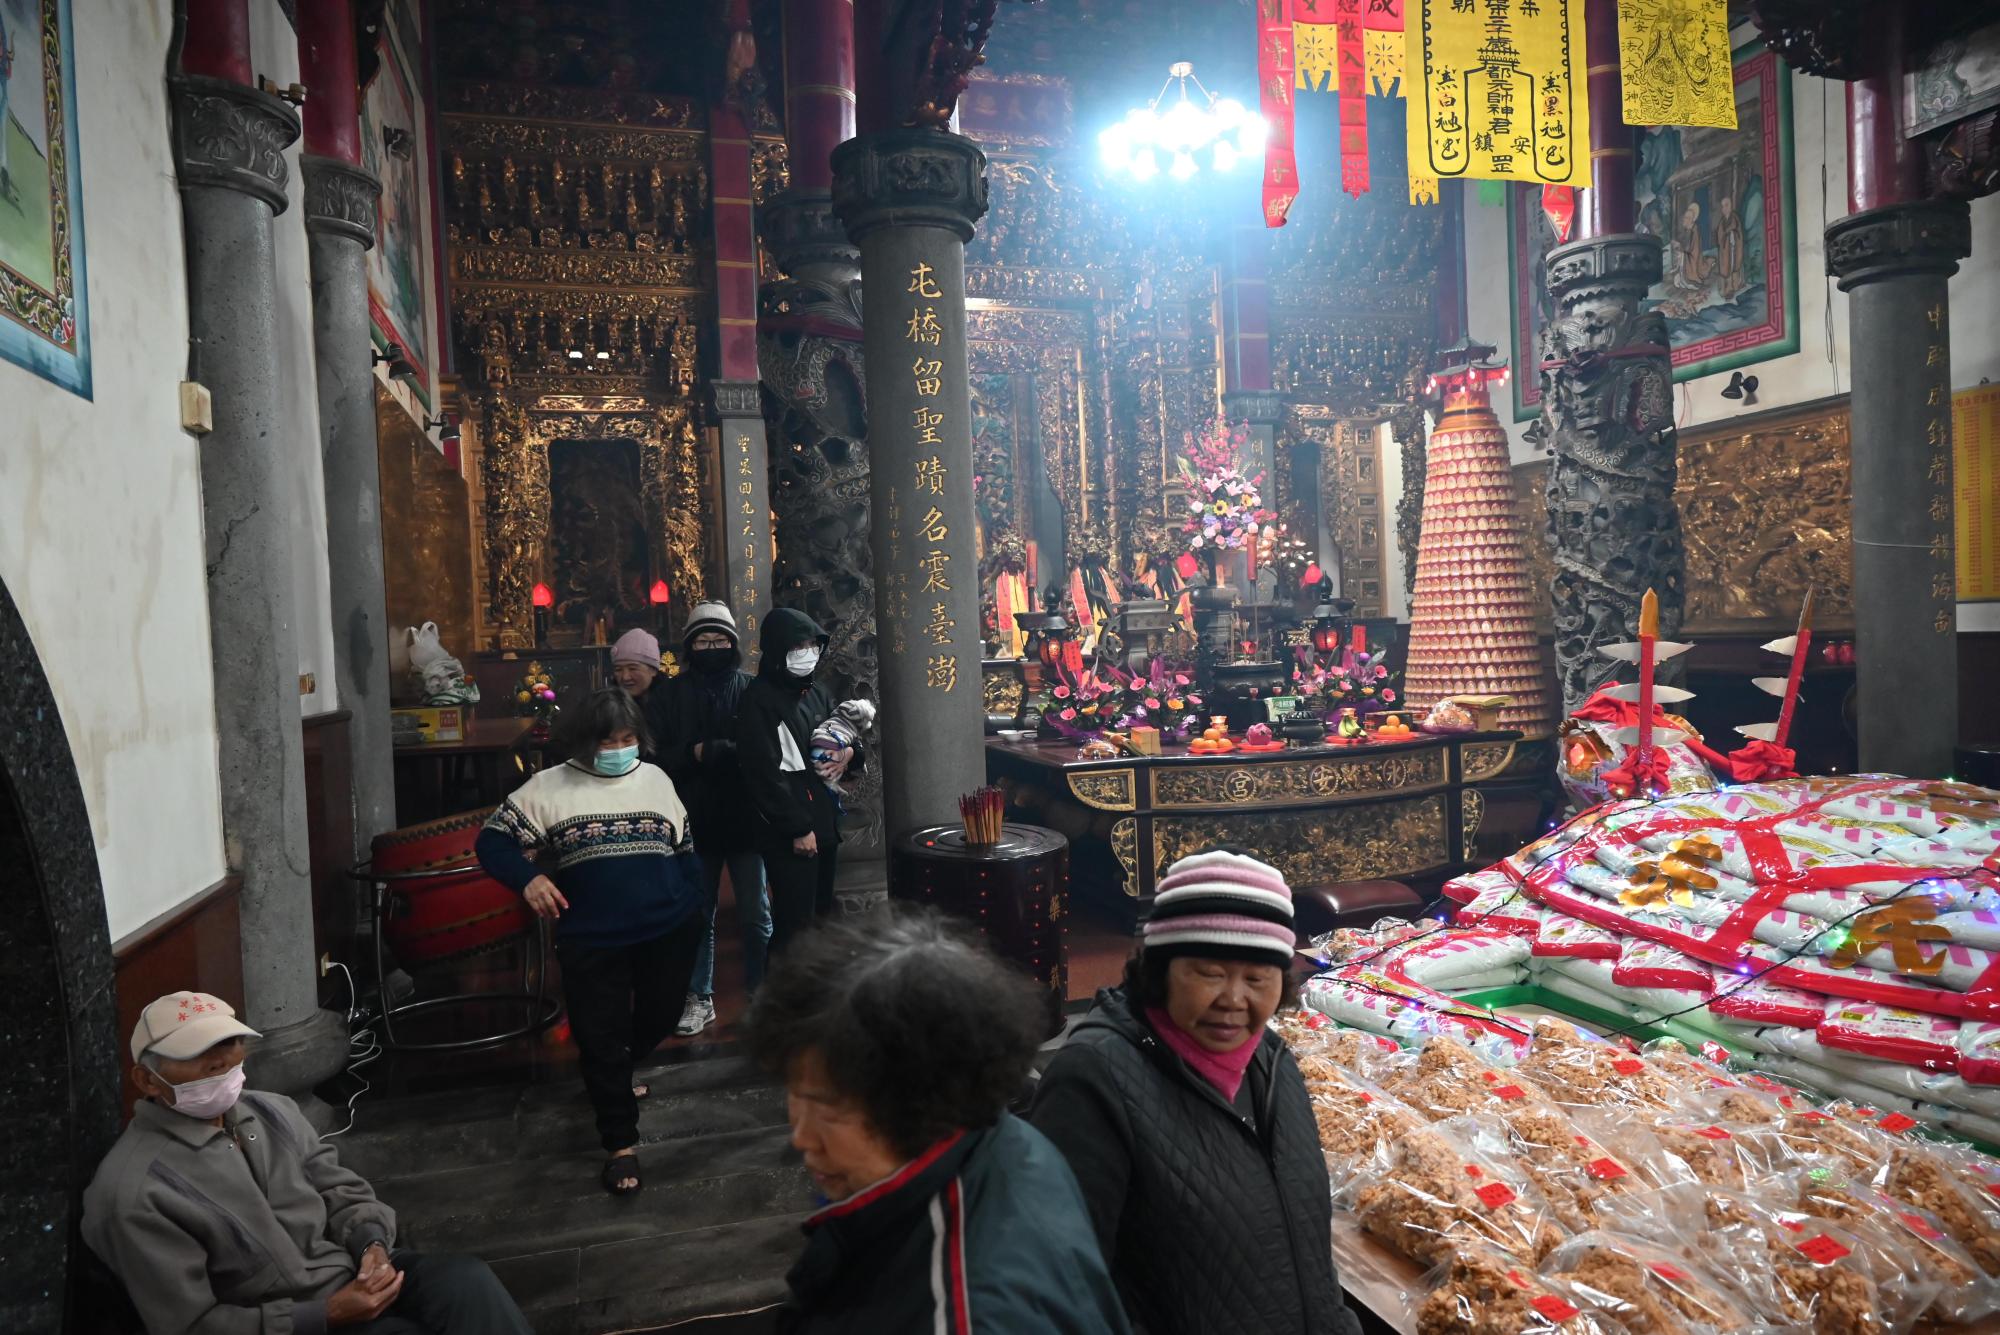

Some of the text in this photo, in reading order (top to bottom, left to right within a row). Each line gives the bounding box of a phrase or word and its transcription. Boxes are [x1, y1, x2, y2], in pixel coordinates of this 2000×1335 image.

[906, 261, 957, 693] 屯橋留聖蹟名震臺澎
